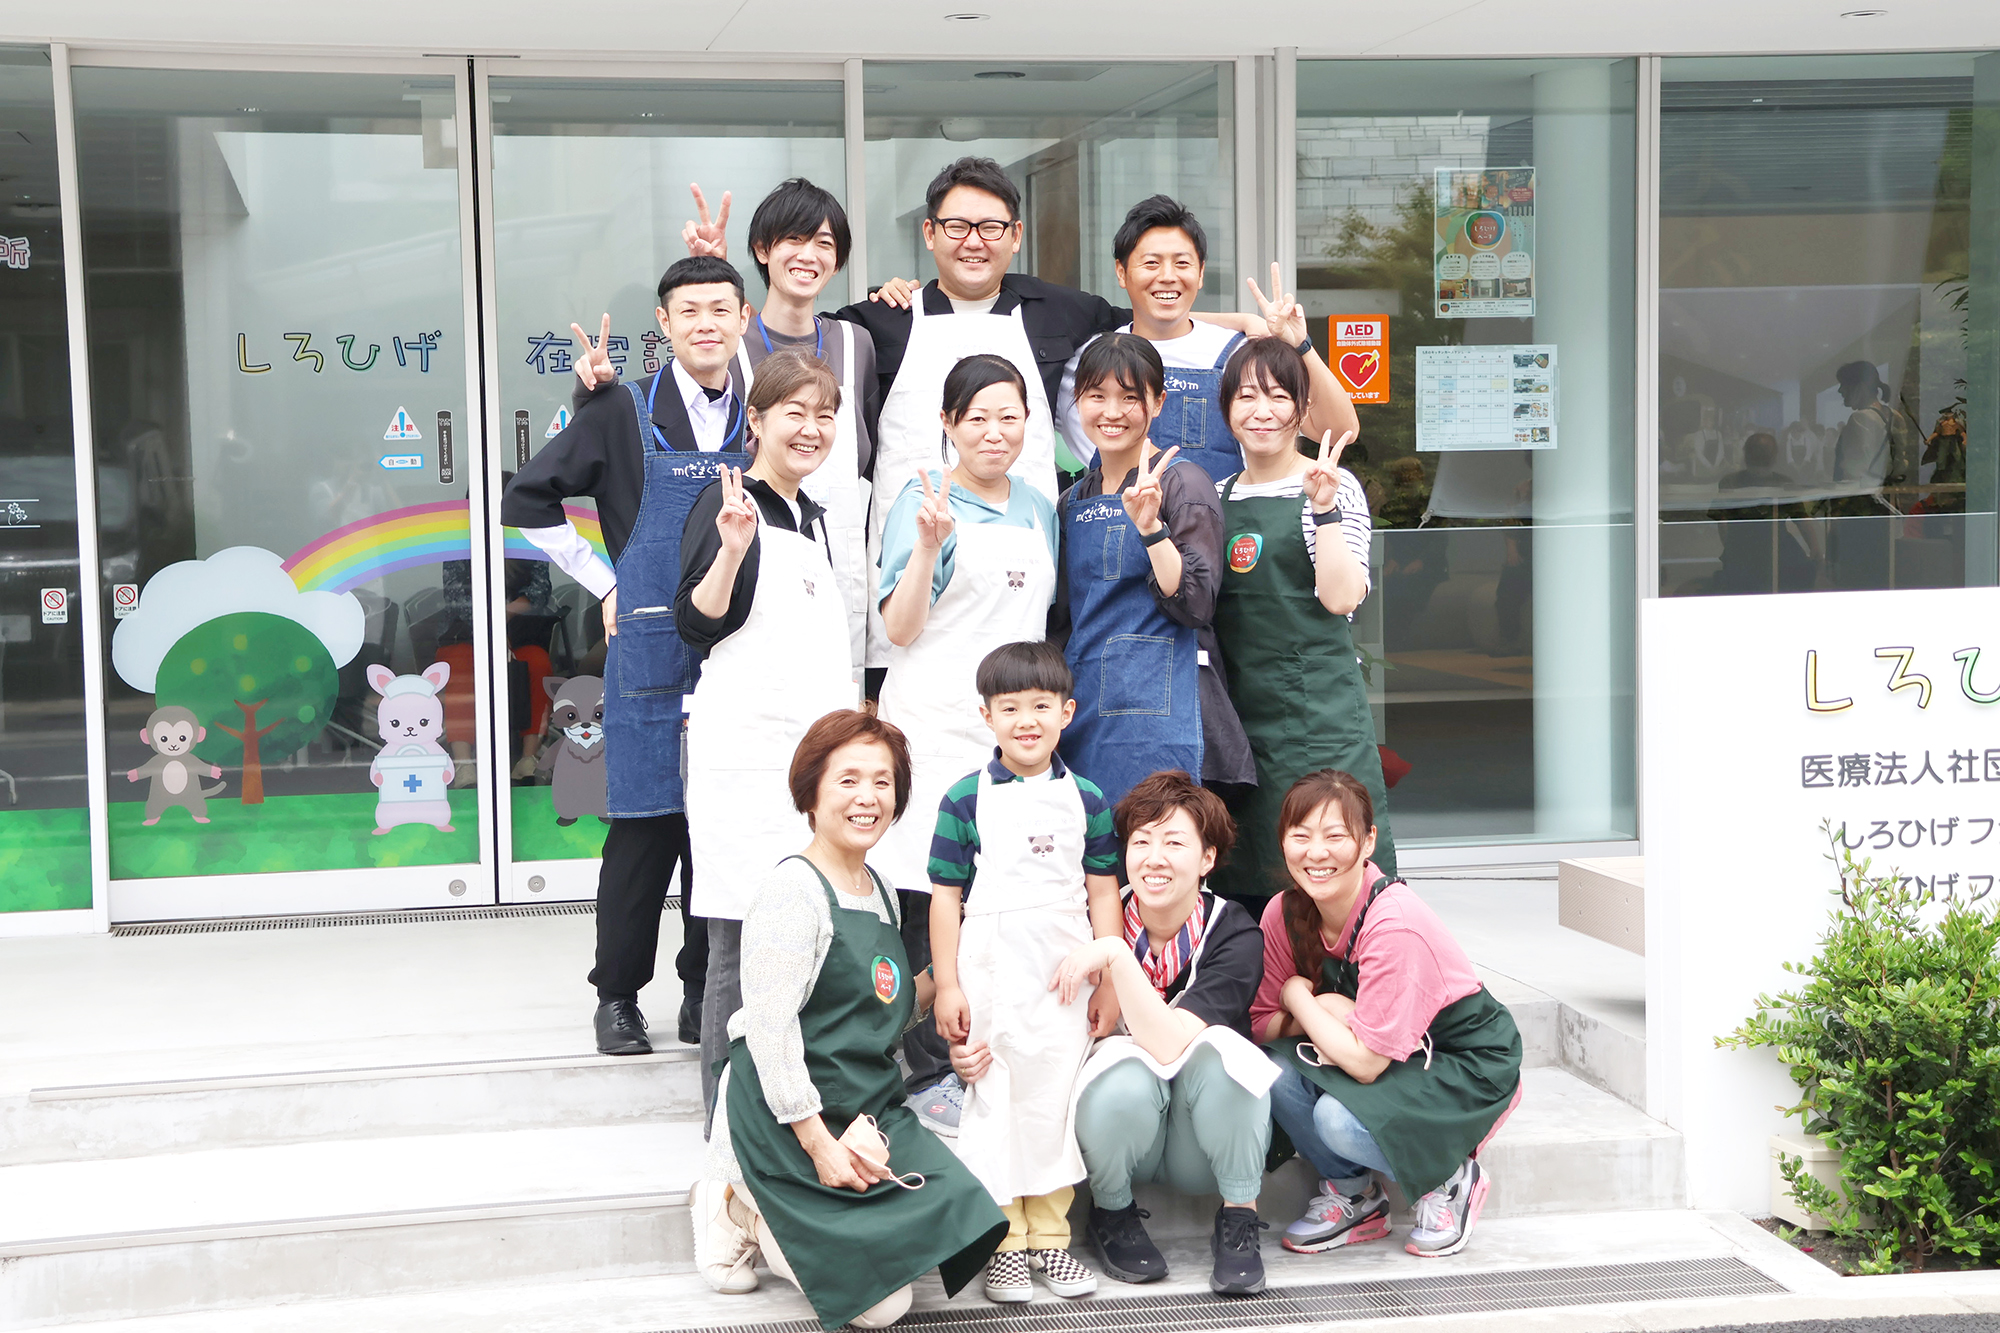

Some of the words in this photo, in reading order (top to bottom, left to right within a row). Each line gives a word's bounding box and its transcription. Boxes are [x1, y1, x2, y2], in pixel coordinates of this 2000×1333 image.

[1344, 324, 1374, 336] AED
[237, 329, 442, 374] しろひげ
[1841, 816, 1960, 850] しろひげ
[1967, 817, 2000, 845] フ
